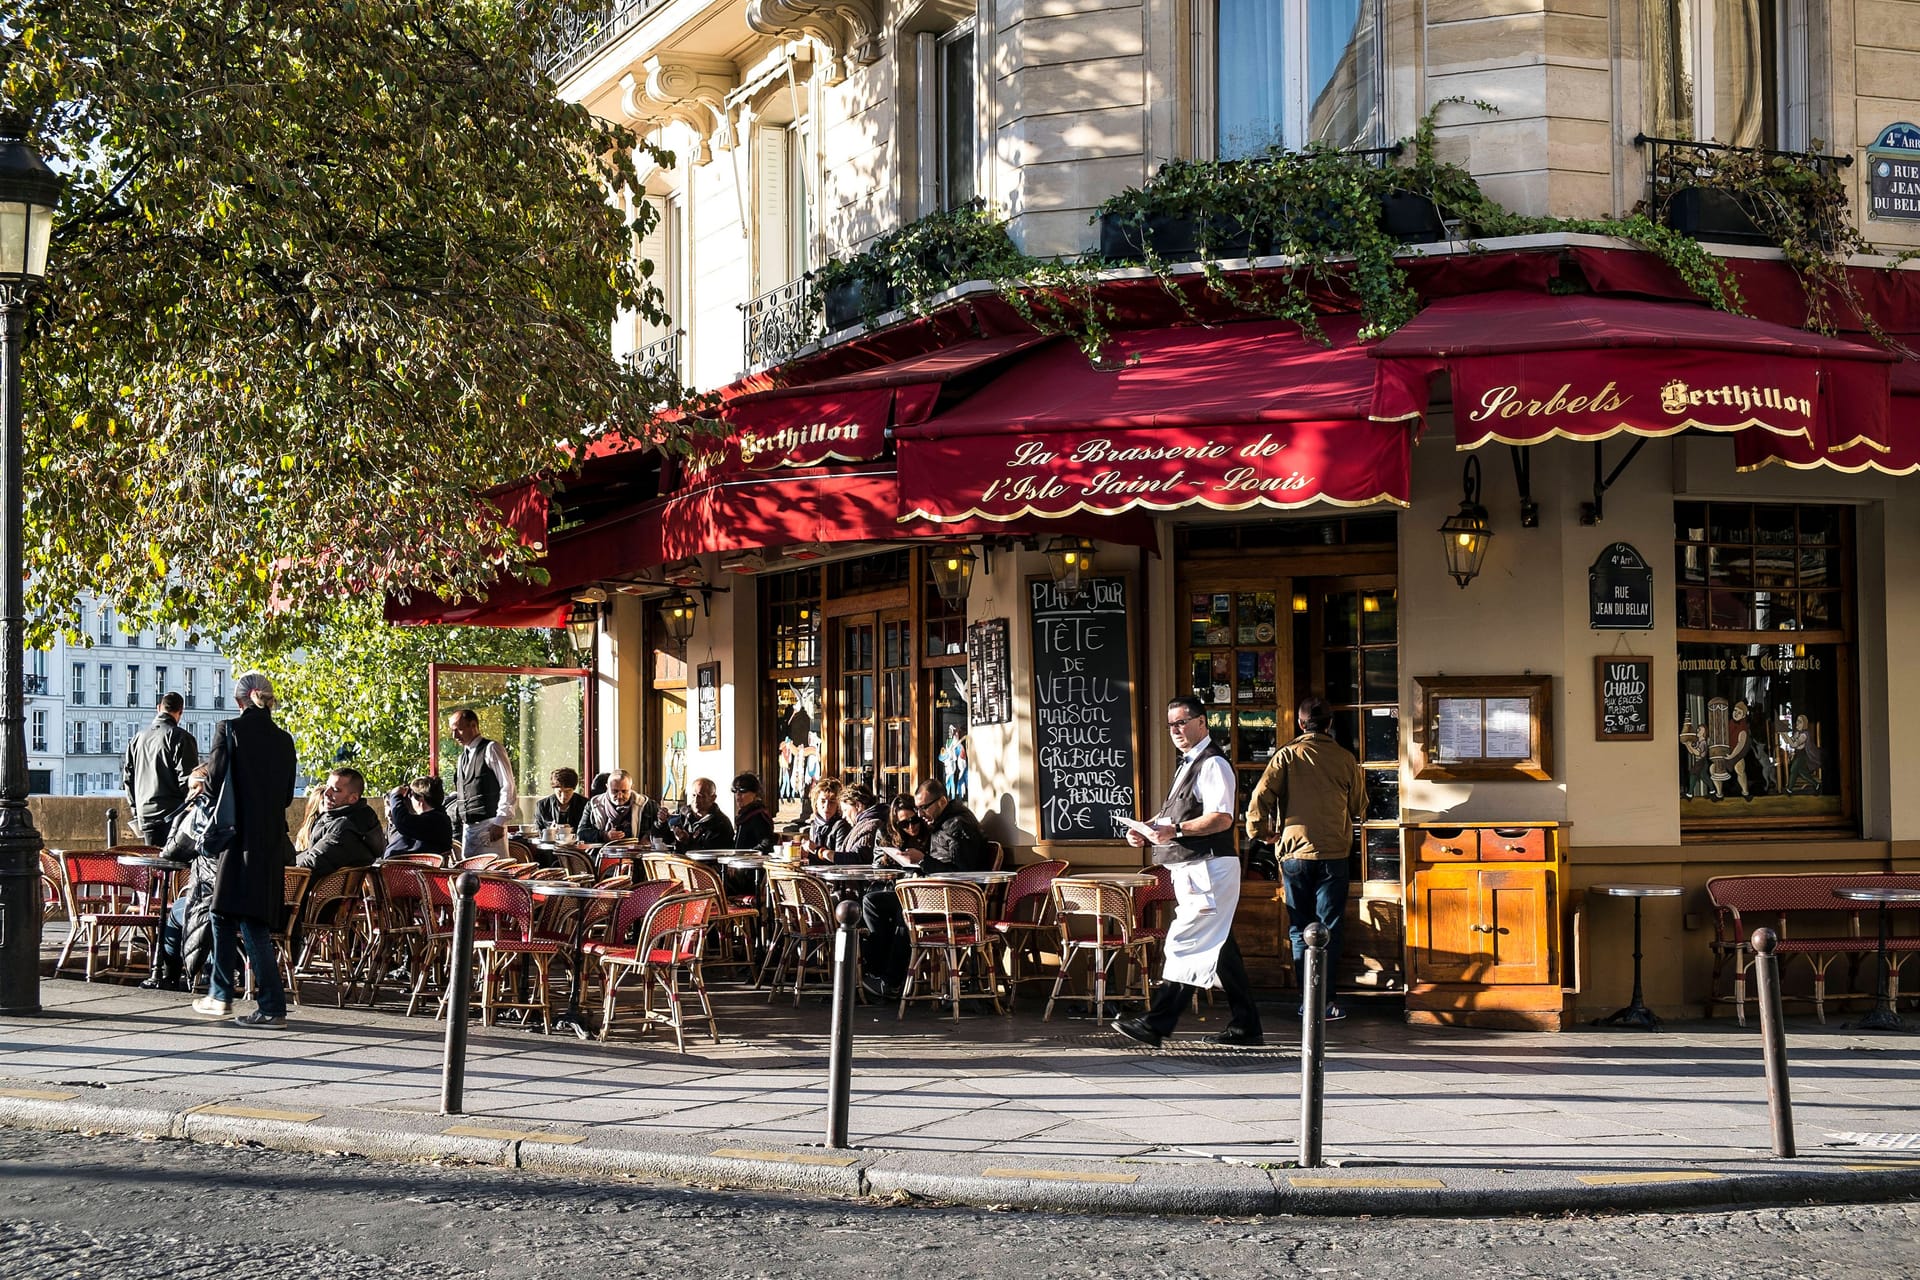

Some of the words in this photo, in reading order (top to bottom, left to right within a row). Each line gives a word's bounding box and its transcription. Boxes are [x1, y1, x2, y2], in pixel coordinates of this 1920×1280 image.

[1894, 165, 1919, 179] RUE
[1874, 197, 1890, 209] DU
[1469, 381, 1634, 422] Sorbets
[1661, 379, 1812, 418] Berthillon
[740, 423, 860, 463] Berthillon
[1006, 441, 1059, 467] La
[1069, 439, 1233, 464] Brasserie
[1240, 433, 1288, 458] de
[1080, 470, 1184, 496] Saint
[1212, 467, 1316, 492] Louis
[1614, 585, 1630, 599] RUE
[1596, 602, 1613, 615] JEAN
[1614, 602, 1624, 615] DU
[1625, 602, 1648, 615] BELLAY
[1036, 617, 1106, 653] TÊTE
[1062, 656, 1085, 673] DE
[1729, 655, 1738, 670] à
[1036, 671, 1119, 704] VEAU
[1604, 681, 1646, 697] CHAUD
[1048, 726, 1111, 746] SAUCE
